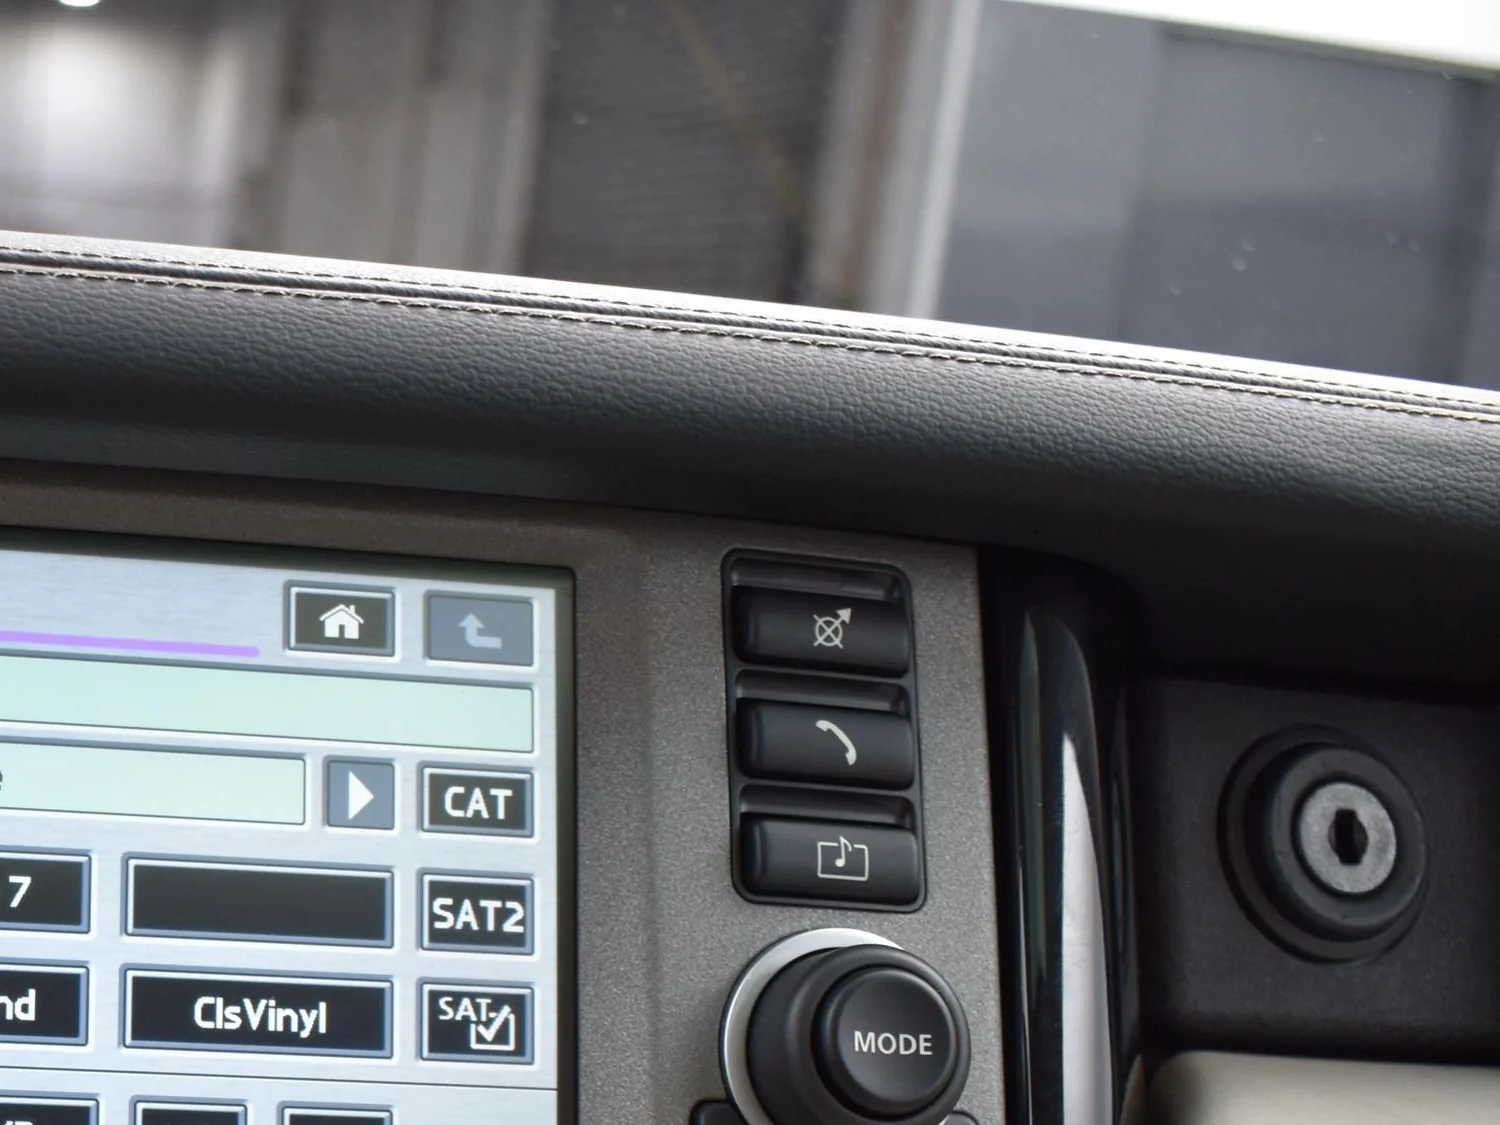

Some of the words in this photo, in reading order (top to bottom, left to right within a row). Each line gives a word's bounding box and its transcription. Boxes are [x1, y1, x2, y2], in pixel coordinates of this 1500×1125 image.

[444, 785, 513, 820] CAT
[8, 875, 32, 908] 7
[432, 897, 525, 933] SAT2
[194, 996, 327, 1039] ClsVinyl
[438, 996, 493, 1022] SAT
[854, 1030, 933, 1056] MODE
